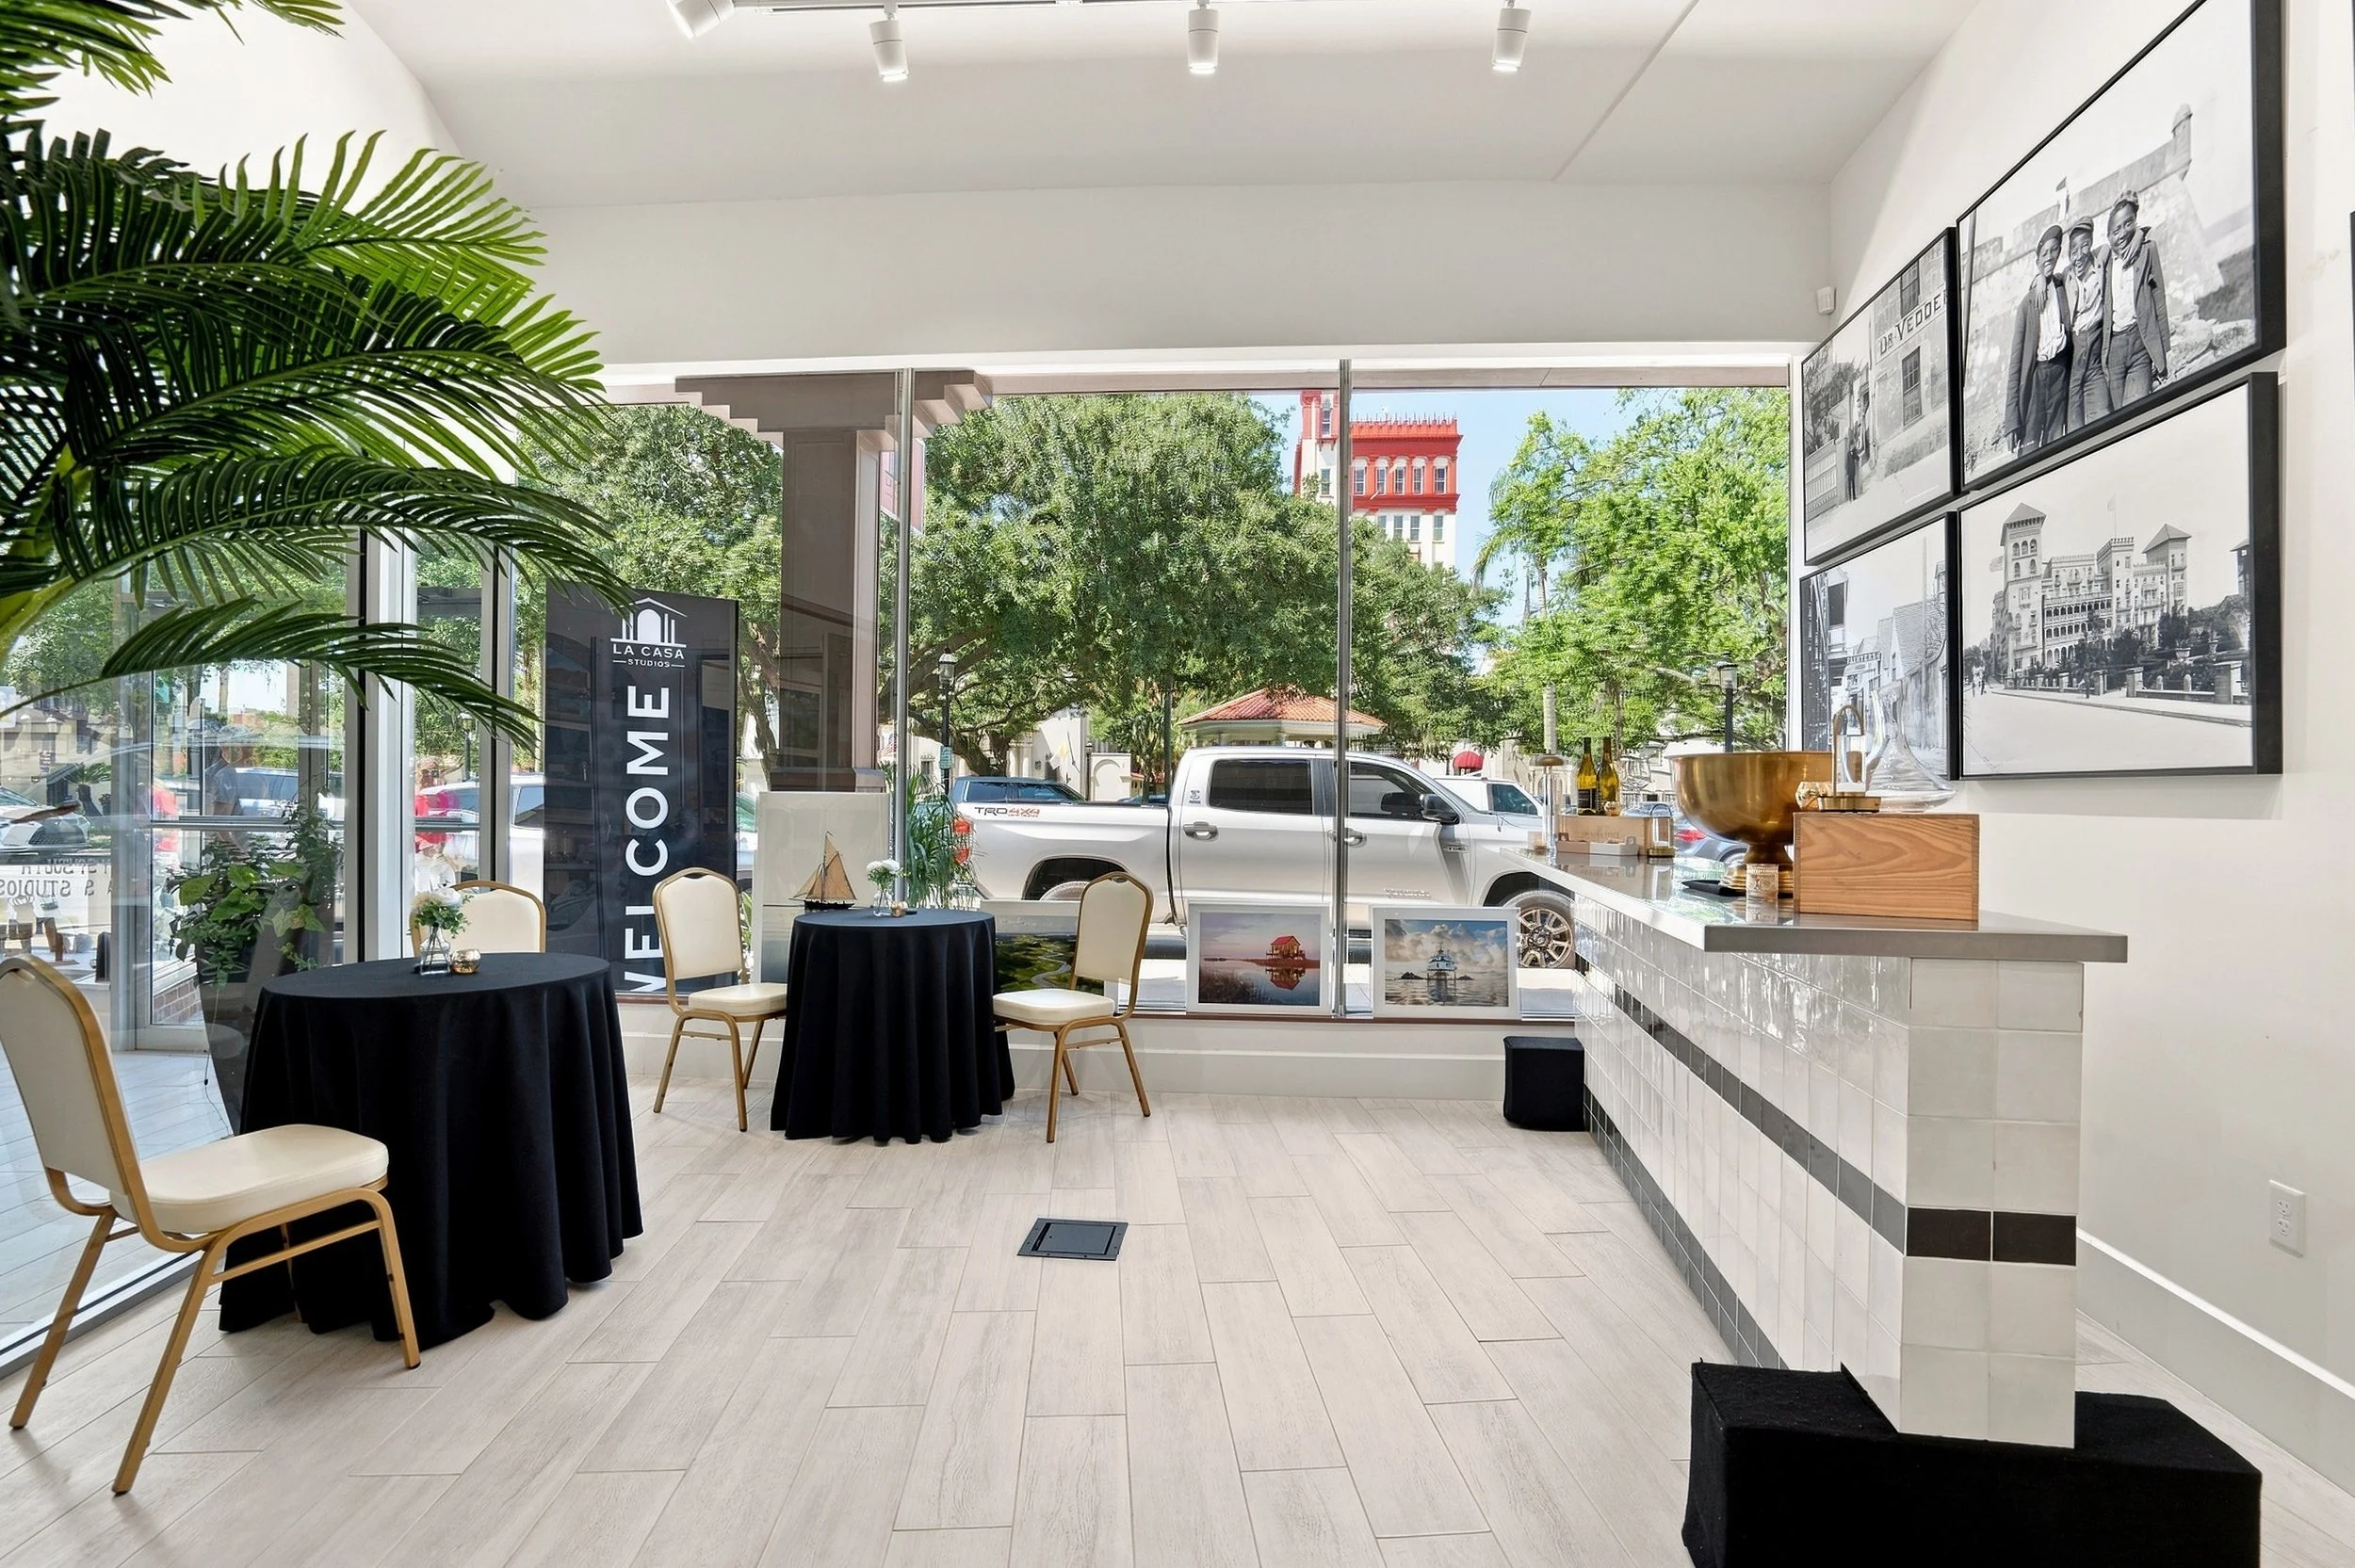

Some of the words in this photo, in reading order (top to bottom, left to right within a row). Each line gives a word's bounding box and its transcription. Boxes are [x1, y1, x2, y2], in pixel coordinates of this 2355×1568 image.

[613, 643, 635, 655] LA
[641, 646, 685, 659] CASA
[627, 659, 671, 668] STUDIOS
